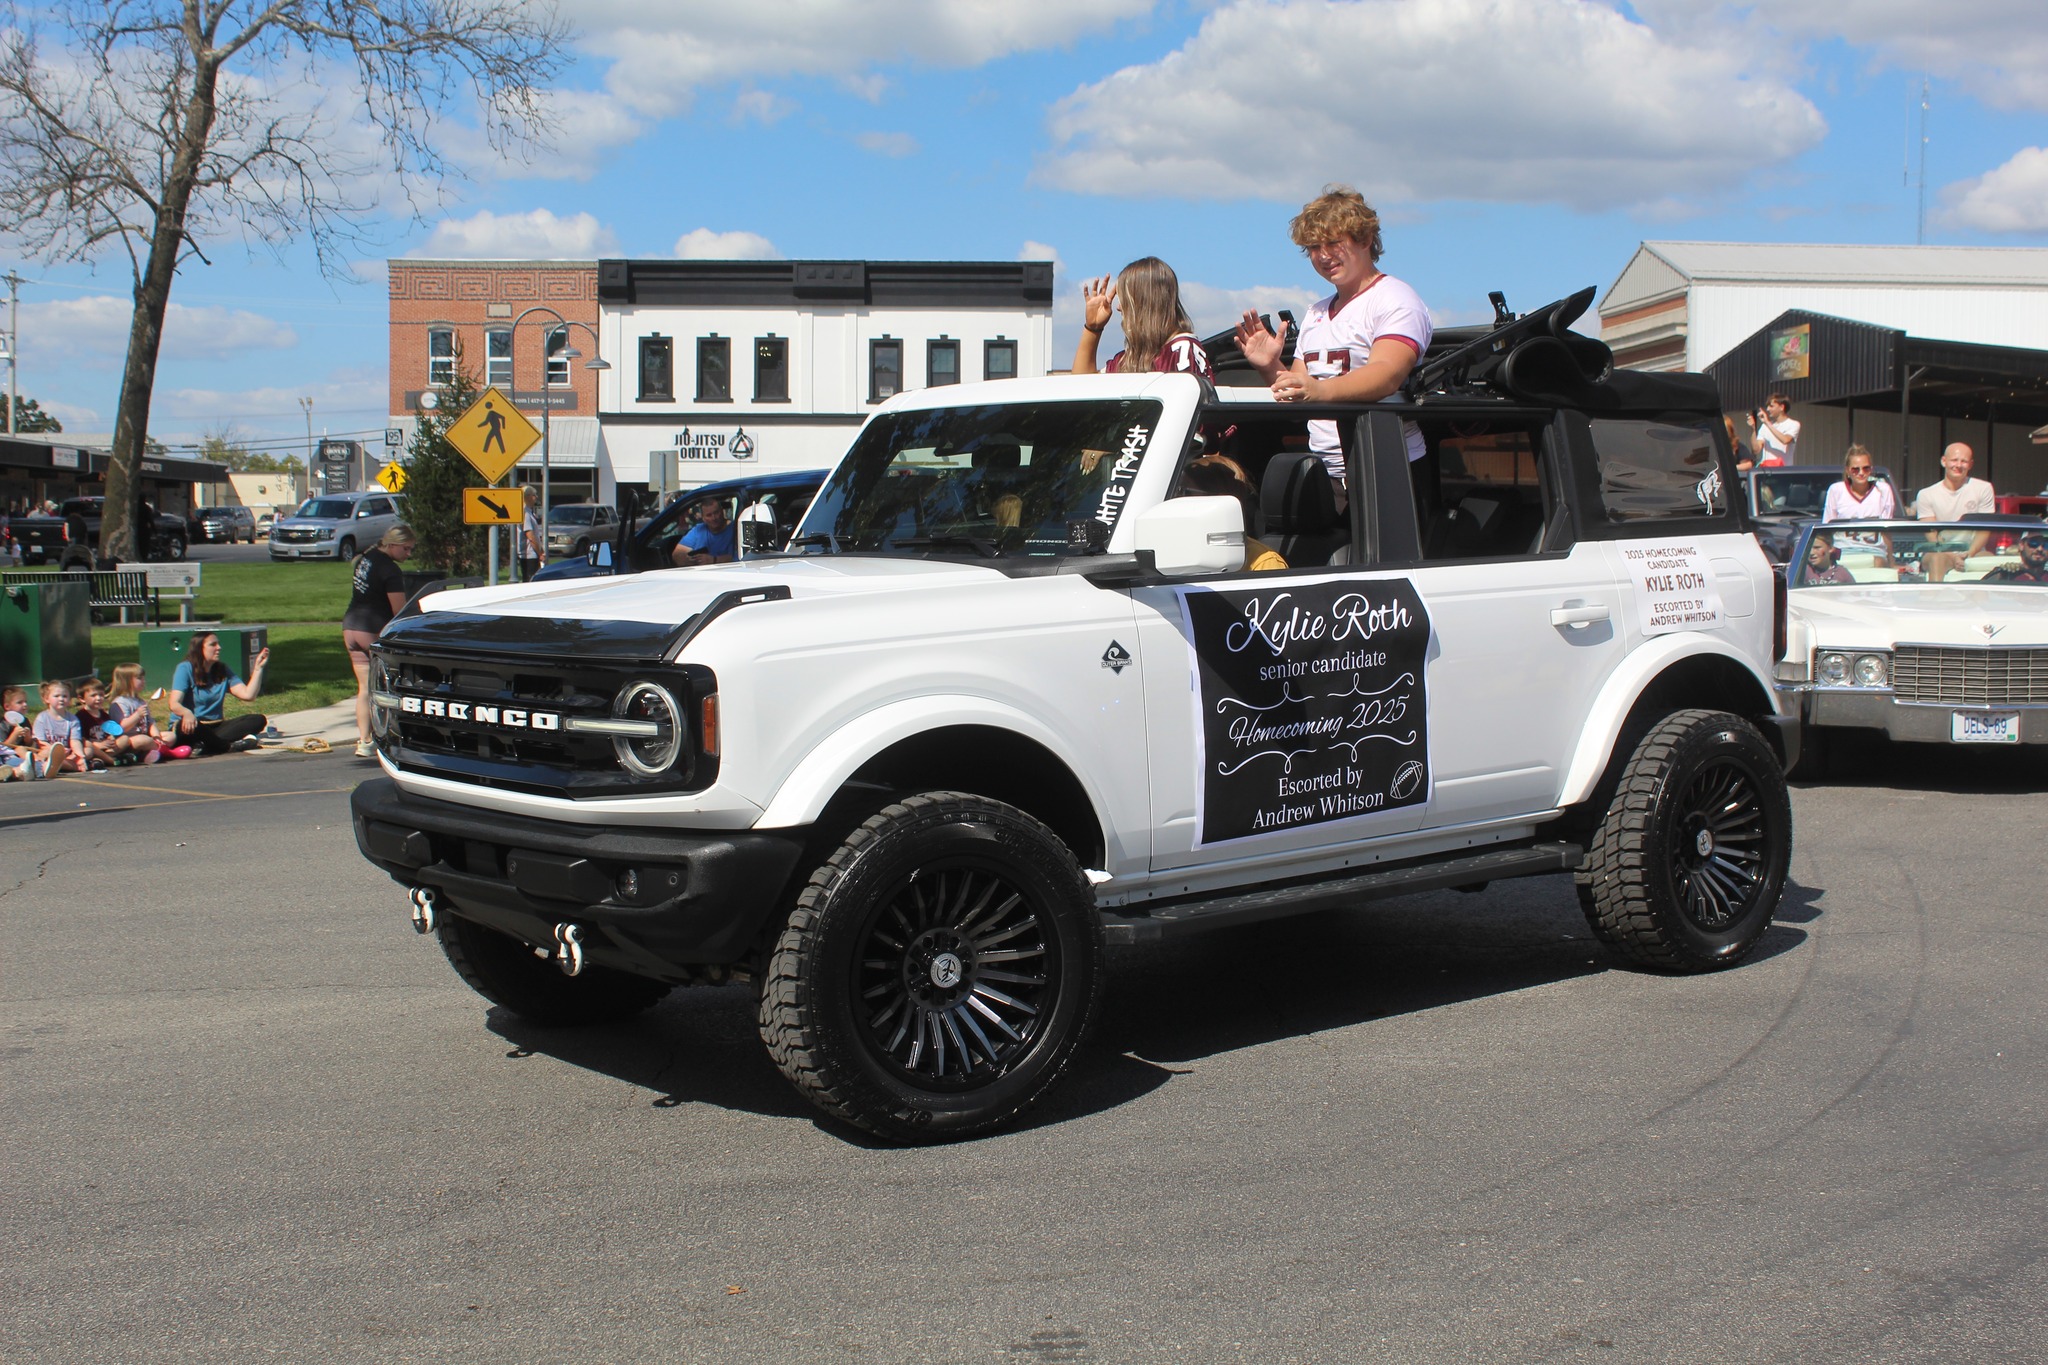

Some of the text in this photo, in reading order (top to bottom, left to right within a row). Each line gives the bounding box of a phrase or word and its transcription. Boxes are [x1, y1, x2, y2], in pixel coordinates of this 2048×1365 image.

[388, 431, 400, 441] 95
[674, 434, 725, 446] JIU-JITSU
[680, 447, 720, 459] OUTLET
[1095, 424, 1149, 526] HITE TRASH
[1625, 546, 1697, 560] 2025 HOMECOMING
[1647, 559, 1689, 570] CANDIDATE
[1644, 572, 1705, 593] KYLIE ROTH
[1653, 599, 1704, 613] ESCORTED BY
[1226, 592, 1413, 656] Kylie Roth
[1650, 610, 1717, 627] ANDREW WHITSON
[1259, 649, 1387, 681] senior candidate
[402, 696, 559, 731] BRONCO
[1228, 694, 1410, 748] Homecoming 2025
[1963, 717, 2007, 734] DELS-69
[1278, 766, 1364, 797] Escorted by
[1252, 791, 1384, 829] Andrew Whitson
